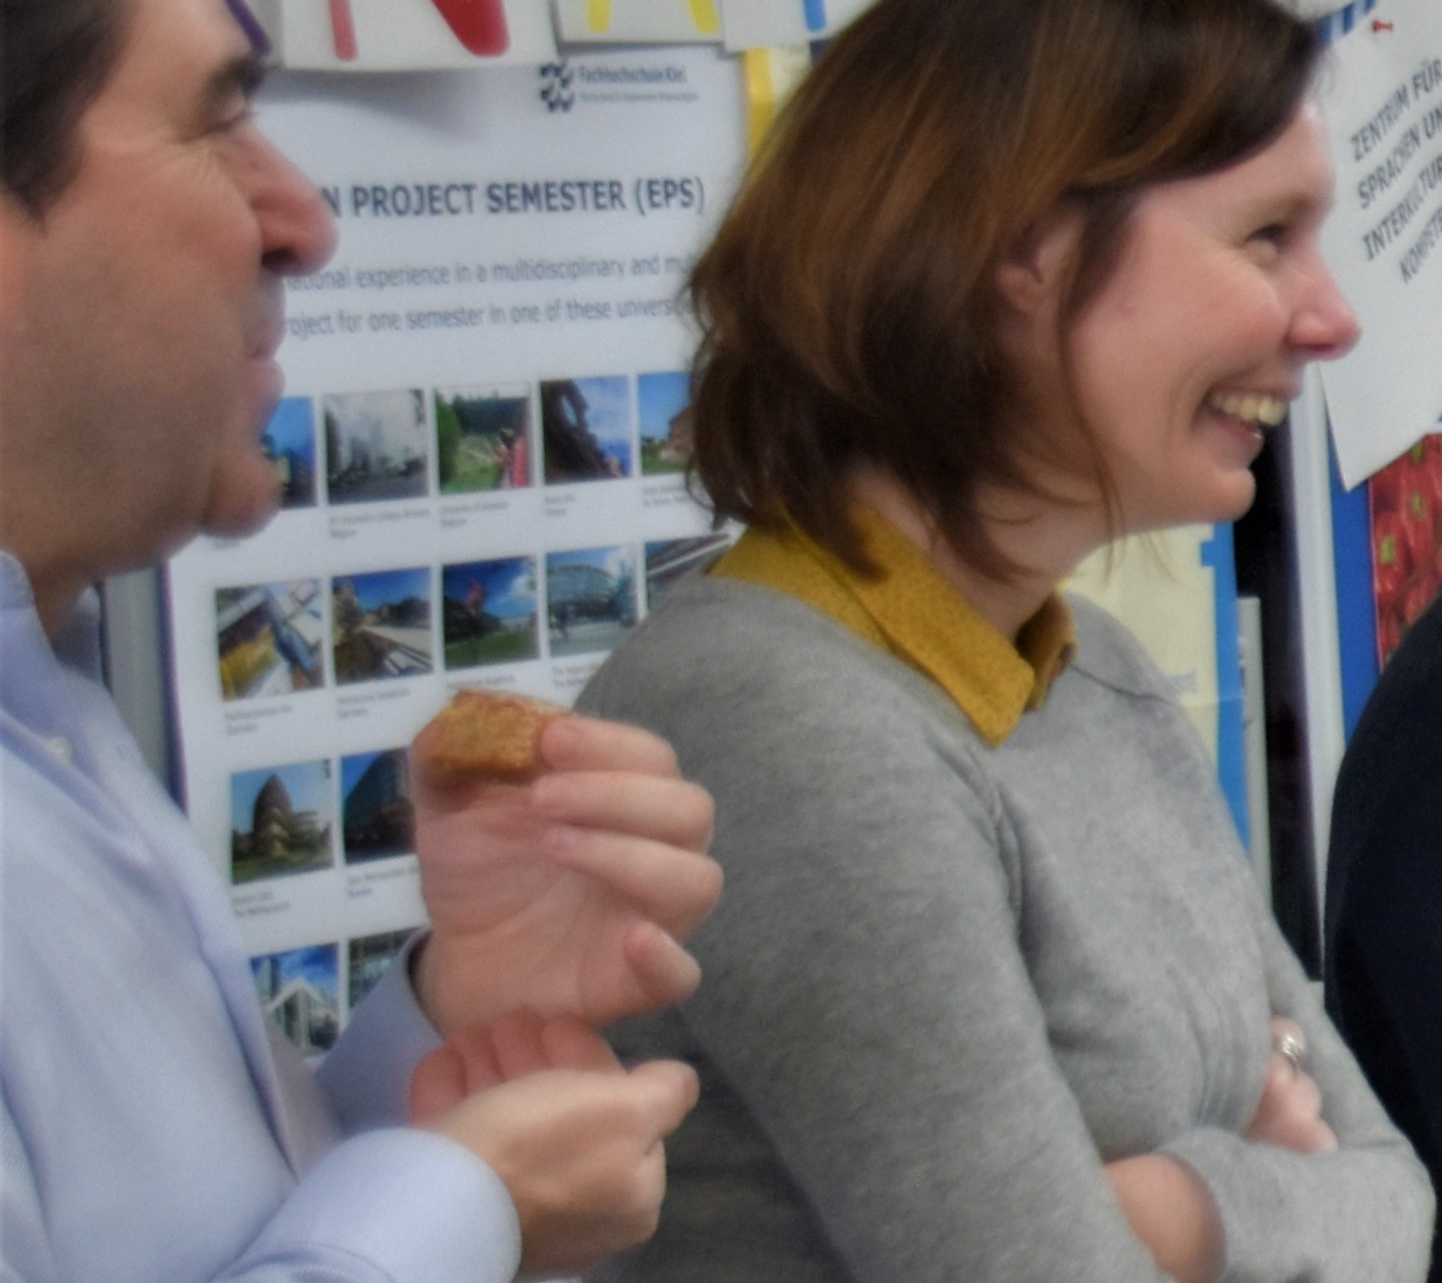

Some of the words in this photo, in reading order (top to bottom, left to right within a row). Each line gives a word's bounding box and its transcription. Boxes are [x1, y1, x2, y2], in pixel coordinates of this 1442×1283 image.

[1357, 122, 1421, 210] SPRACHEN
[352, 182, 477, 219] PROJECT
[484, 179, 627, 216] SEMESTER
[634, 175, 706, 220] (EPS)
[355, 264, 450, 292] experience
[455, 262, 472, 284] in
[477, 264, 487, 282] a
[492, 254, 625, 281] multidisciplinary
[630, 254, 660, 276] and
[336, 308, 361, 333] for
[367, 311, 402, 333] one
[404, 304, 484, 331] semester
[487, 301, 507, 324] in
[509, 304, 541, 325] one
[545, 298, 562, 323] of
[565, 298, 612, 321] these
